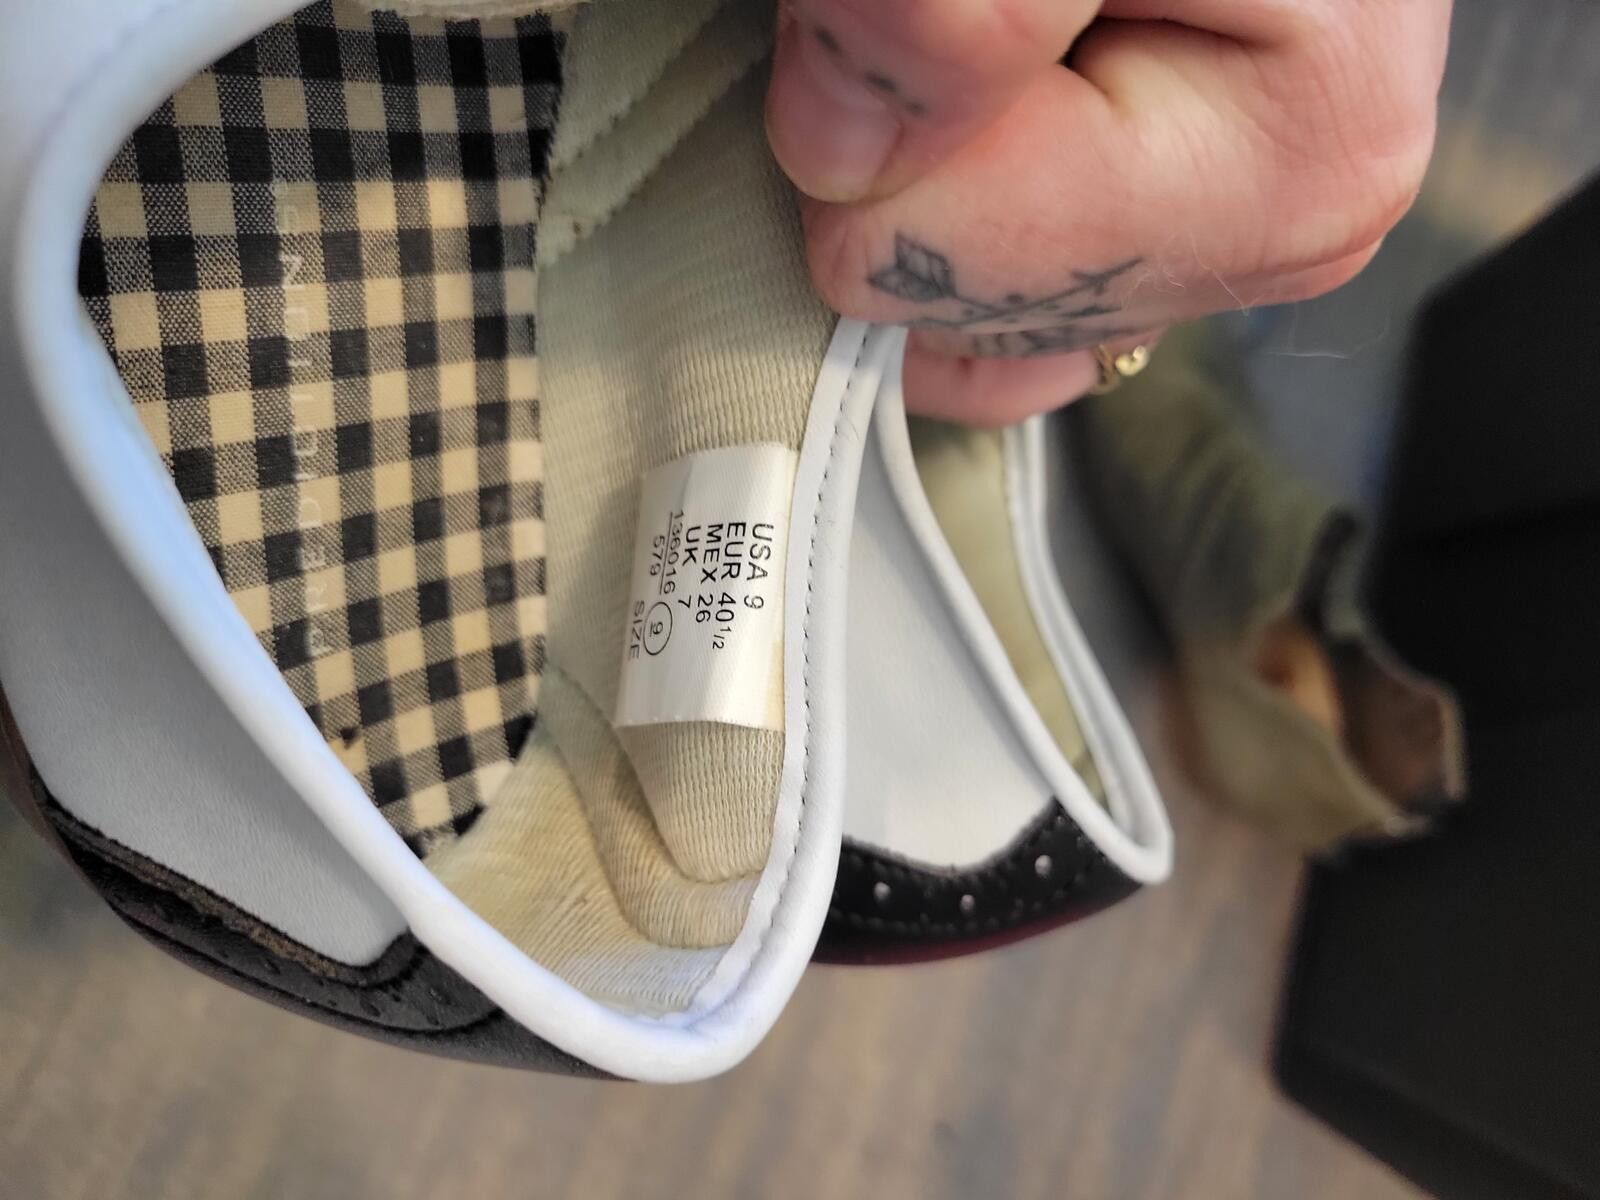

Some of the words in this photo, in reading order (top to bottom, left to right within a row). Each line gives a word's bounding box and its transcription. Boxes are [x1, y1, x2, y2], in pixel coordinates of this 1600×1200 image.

[650, 535, 666, 576] 579
[663, 509, 684, 595] 136016
[682, 526, 702, 566] UK
[700, 523, 724, 584] MEX
[720, 521, 746, 580] EUR
[746, 522, 774, 581] USA
[678, 594, 692, 609] 7
[695, 593, 714, 623] 26
[743, 594, 765, 610] 9
[630, 600, 645, 660] SIZE
[651, 621, 664, 635] 9
